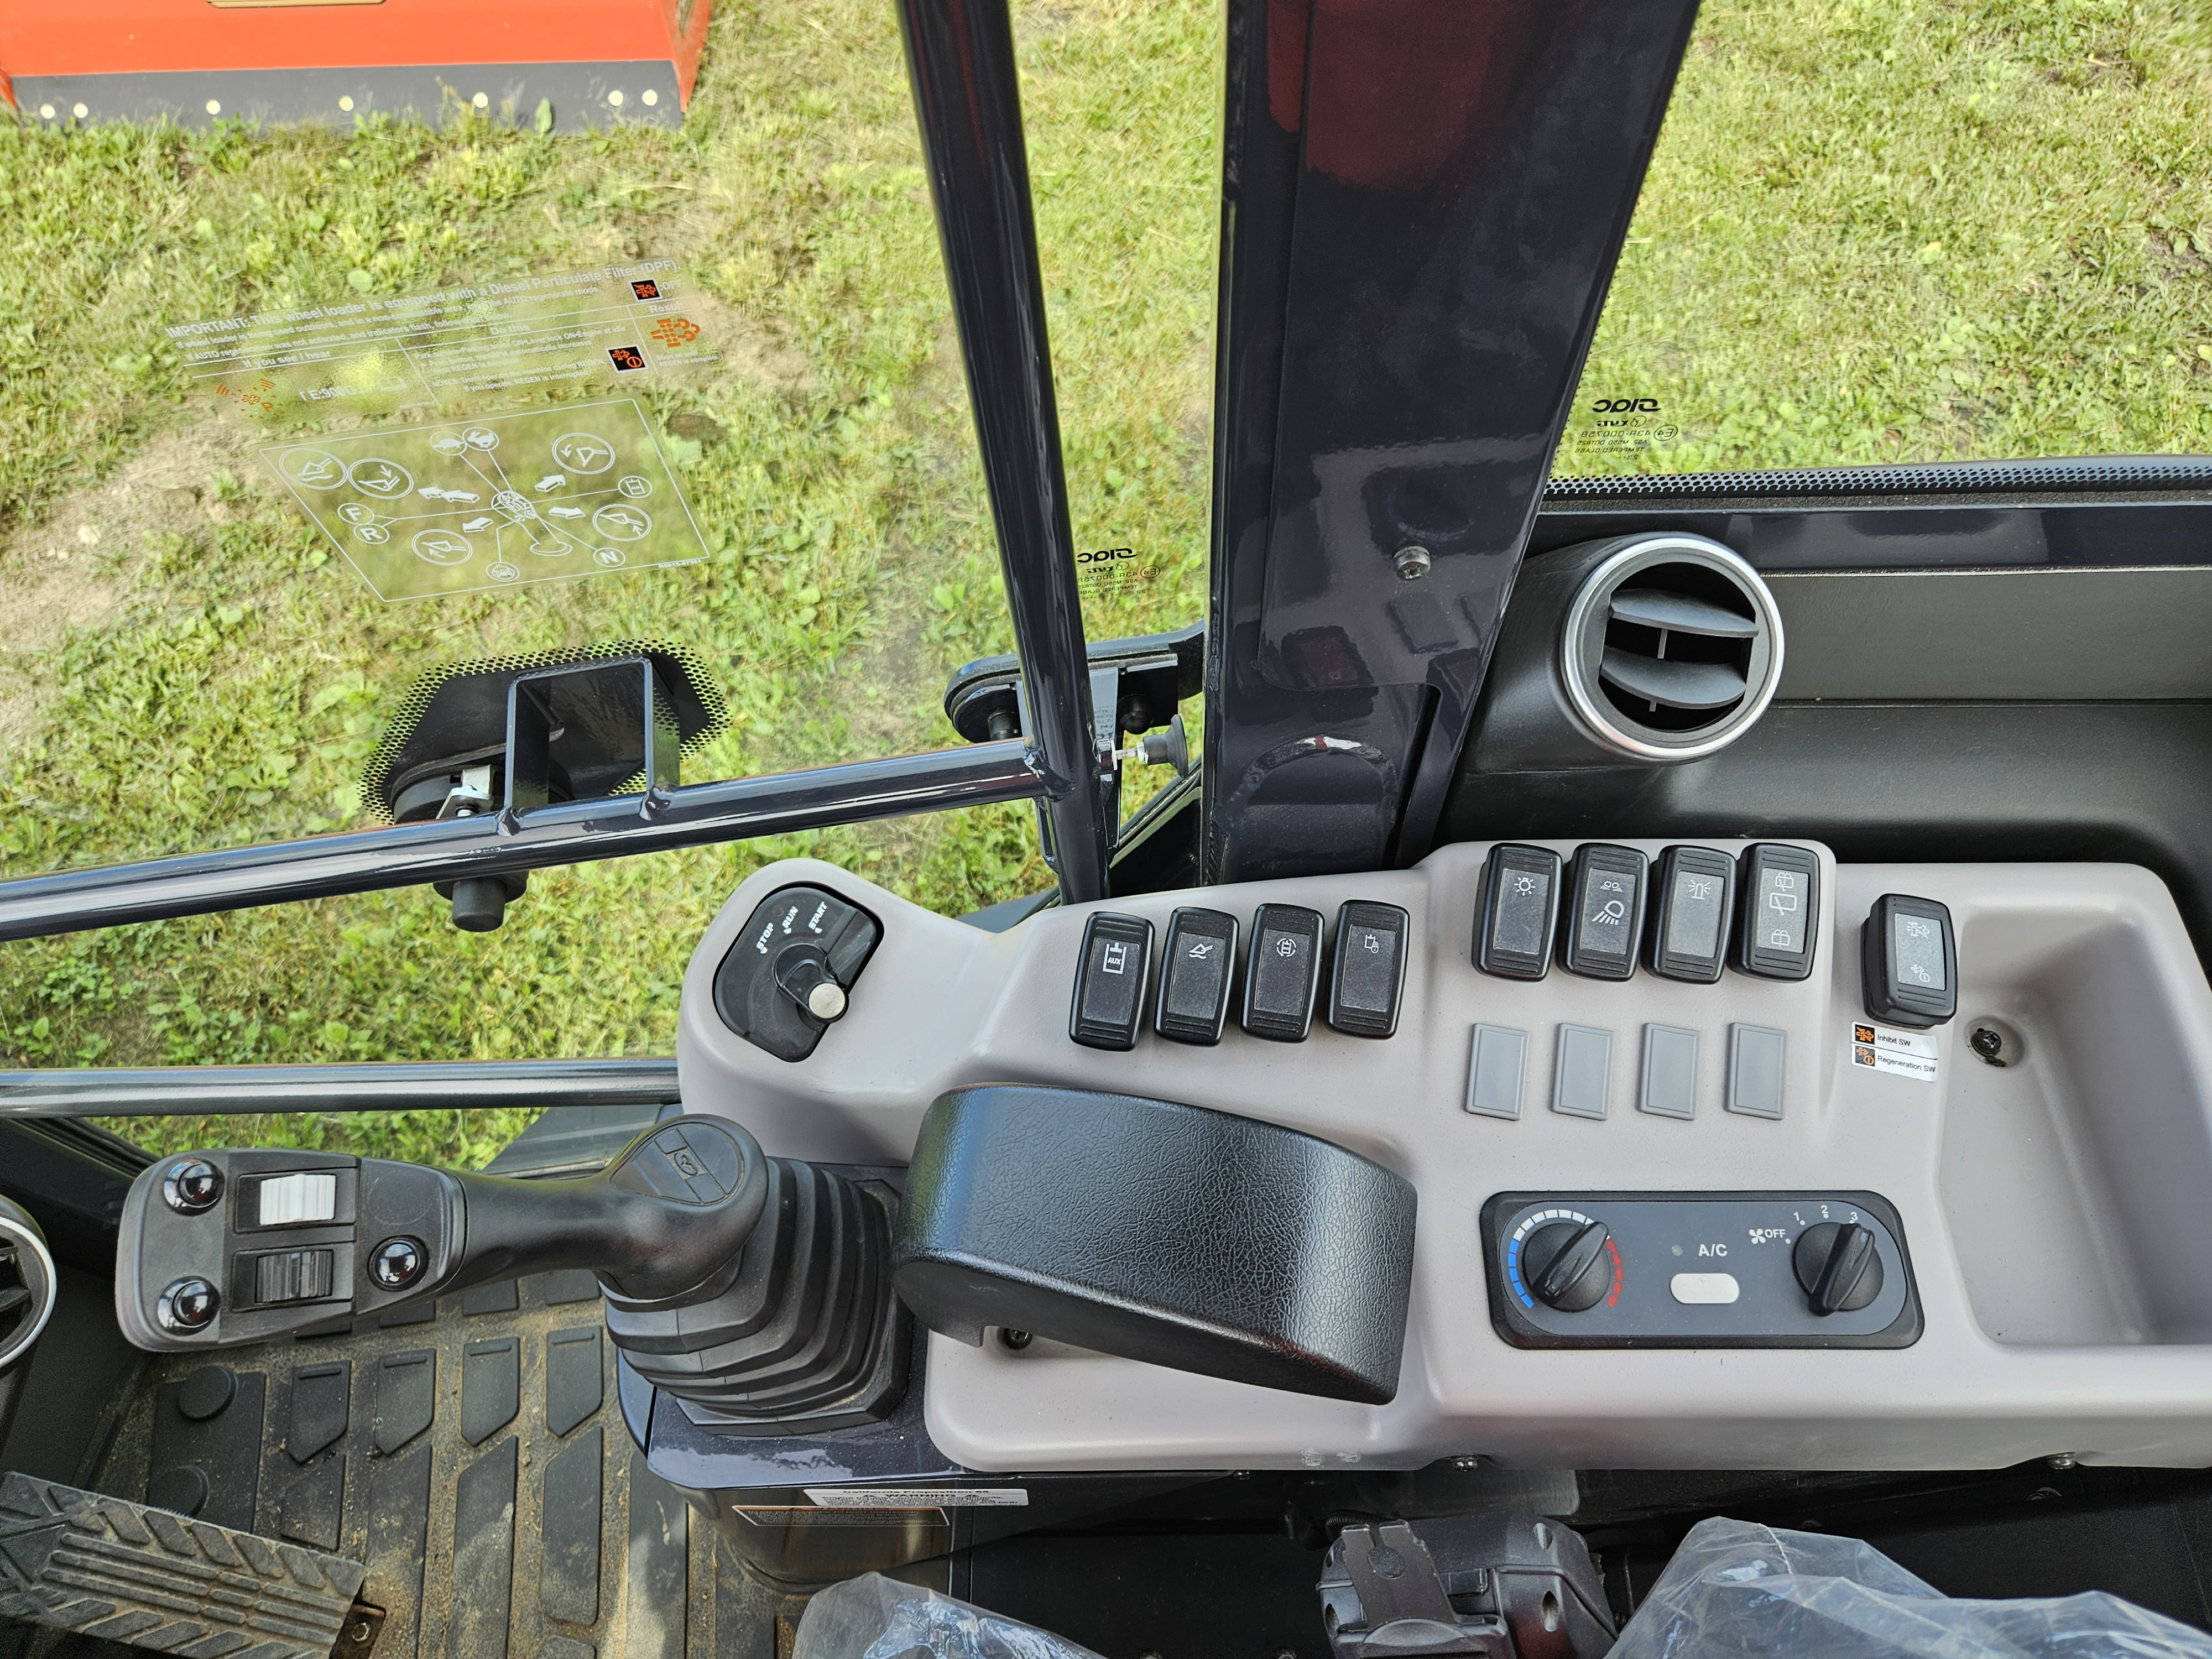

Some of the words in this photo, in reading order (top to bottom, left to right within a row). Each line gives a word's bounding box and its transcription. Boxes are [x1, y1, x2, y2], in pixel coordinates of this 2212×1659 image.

[166, 317, 252, 338] IMPORTANT:
[252, 314, 282, 327] This
[284, 307, 324, 322] wheel
[324, 302, 366, 316] loader
[369, 301, 383, 311] is
[385, 292, 446, 309] equipped
[448, 287, 477, 300] with
[478, 287, 488, 296] a
[489, 281, 530, 296] Diesel
[532, 272, 602, 289] Particulate
[604, 264, 636, 279] Filter
[640, 258, 681, 275] (DPF).
[210, 335, 237, 345] loader
[274, 327, 295, 337] used
[296, 322, 338, 333] outdoors,
[338, 319, 354, 327] and
[504, 295, 528, 305] AUTO
[489, 326, 506, 336] Do
[509, 322, 531, 333] this
[195, 350, 219, 360] AUTO
[275, 341, 291, 349] was
[293, 338, 307, 347] not
[350, 330, 367, 339] and
[434, 319, 461, 328] follow
[242, 358, 252, 369] If
[254, 357, 276, 370] you
[278, 354, 298, 364] see
[305, 349, 332, 361] hear
[514, 374, 541, 385] REGEN
[782, 906, 799, 929] RUN
[808, 901, 827, 930] START
[756, 922, 774, 951] STOP
[1107, 957, 1121, 966] AUX
[1877, 1034, 1897, 1044] Inhibit
[1898, 1039, 1911, 1047] SW
[1877, 1055, 1922, 1071] Regeneration
[1821, 1204, 1829, 1214] 2
[1793, 1212, 1799, 1221] 1
[1850, 1212, 1859, 1221] 3
[1764, 1228, 1786, 1238] OFF
[1698, 1244, 1728, 1257] A/C
